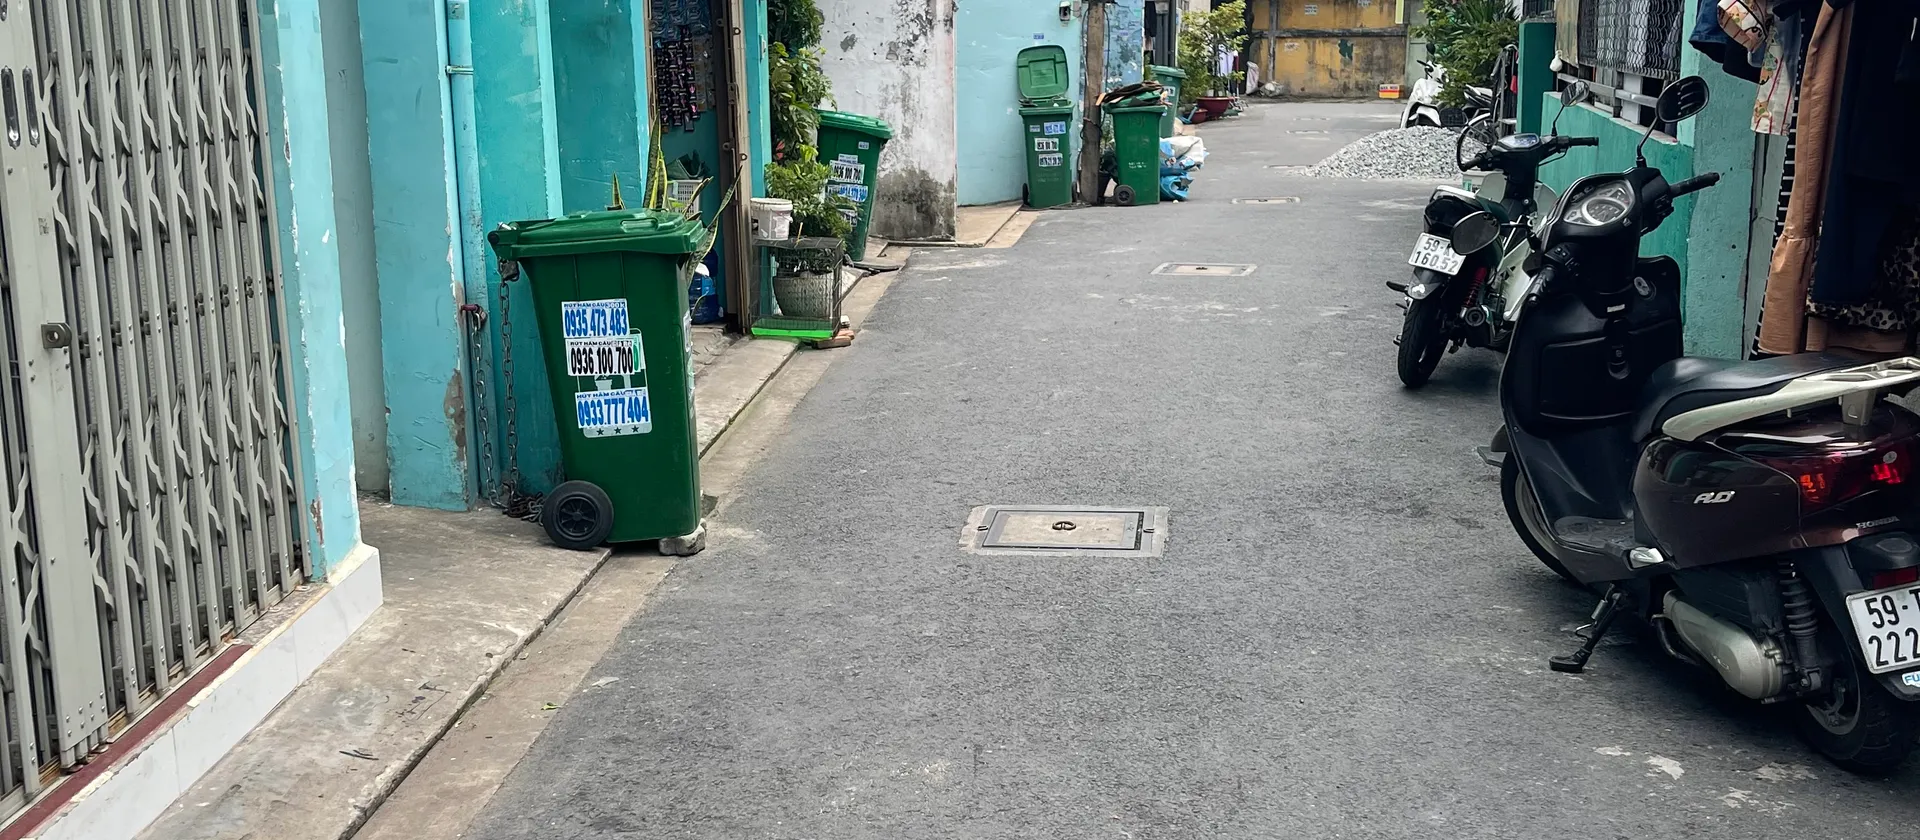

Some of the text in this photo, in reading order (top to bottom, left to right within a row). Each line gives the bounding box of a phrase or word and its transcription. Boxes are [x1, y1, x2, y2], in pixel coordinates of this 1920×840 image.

[1415, 251, 1458, 272] 160.52
[565, 308, 628, 336] 0935.473.483
[571, 347, 633, 374] 0936.100.700
[577, 396, 649, 427] 0933.777.404
[1856, 516, 1900, 528] HONDA
[1868, 627, 1920, 667] 222
